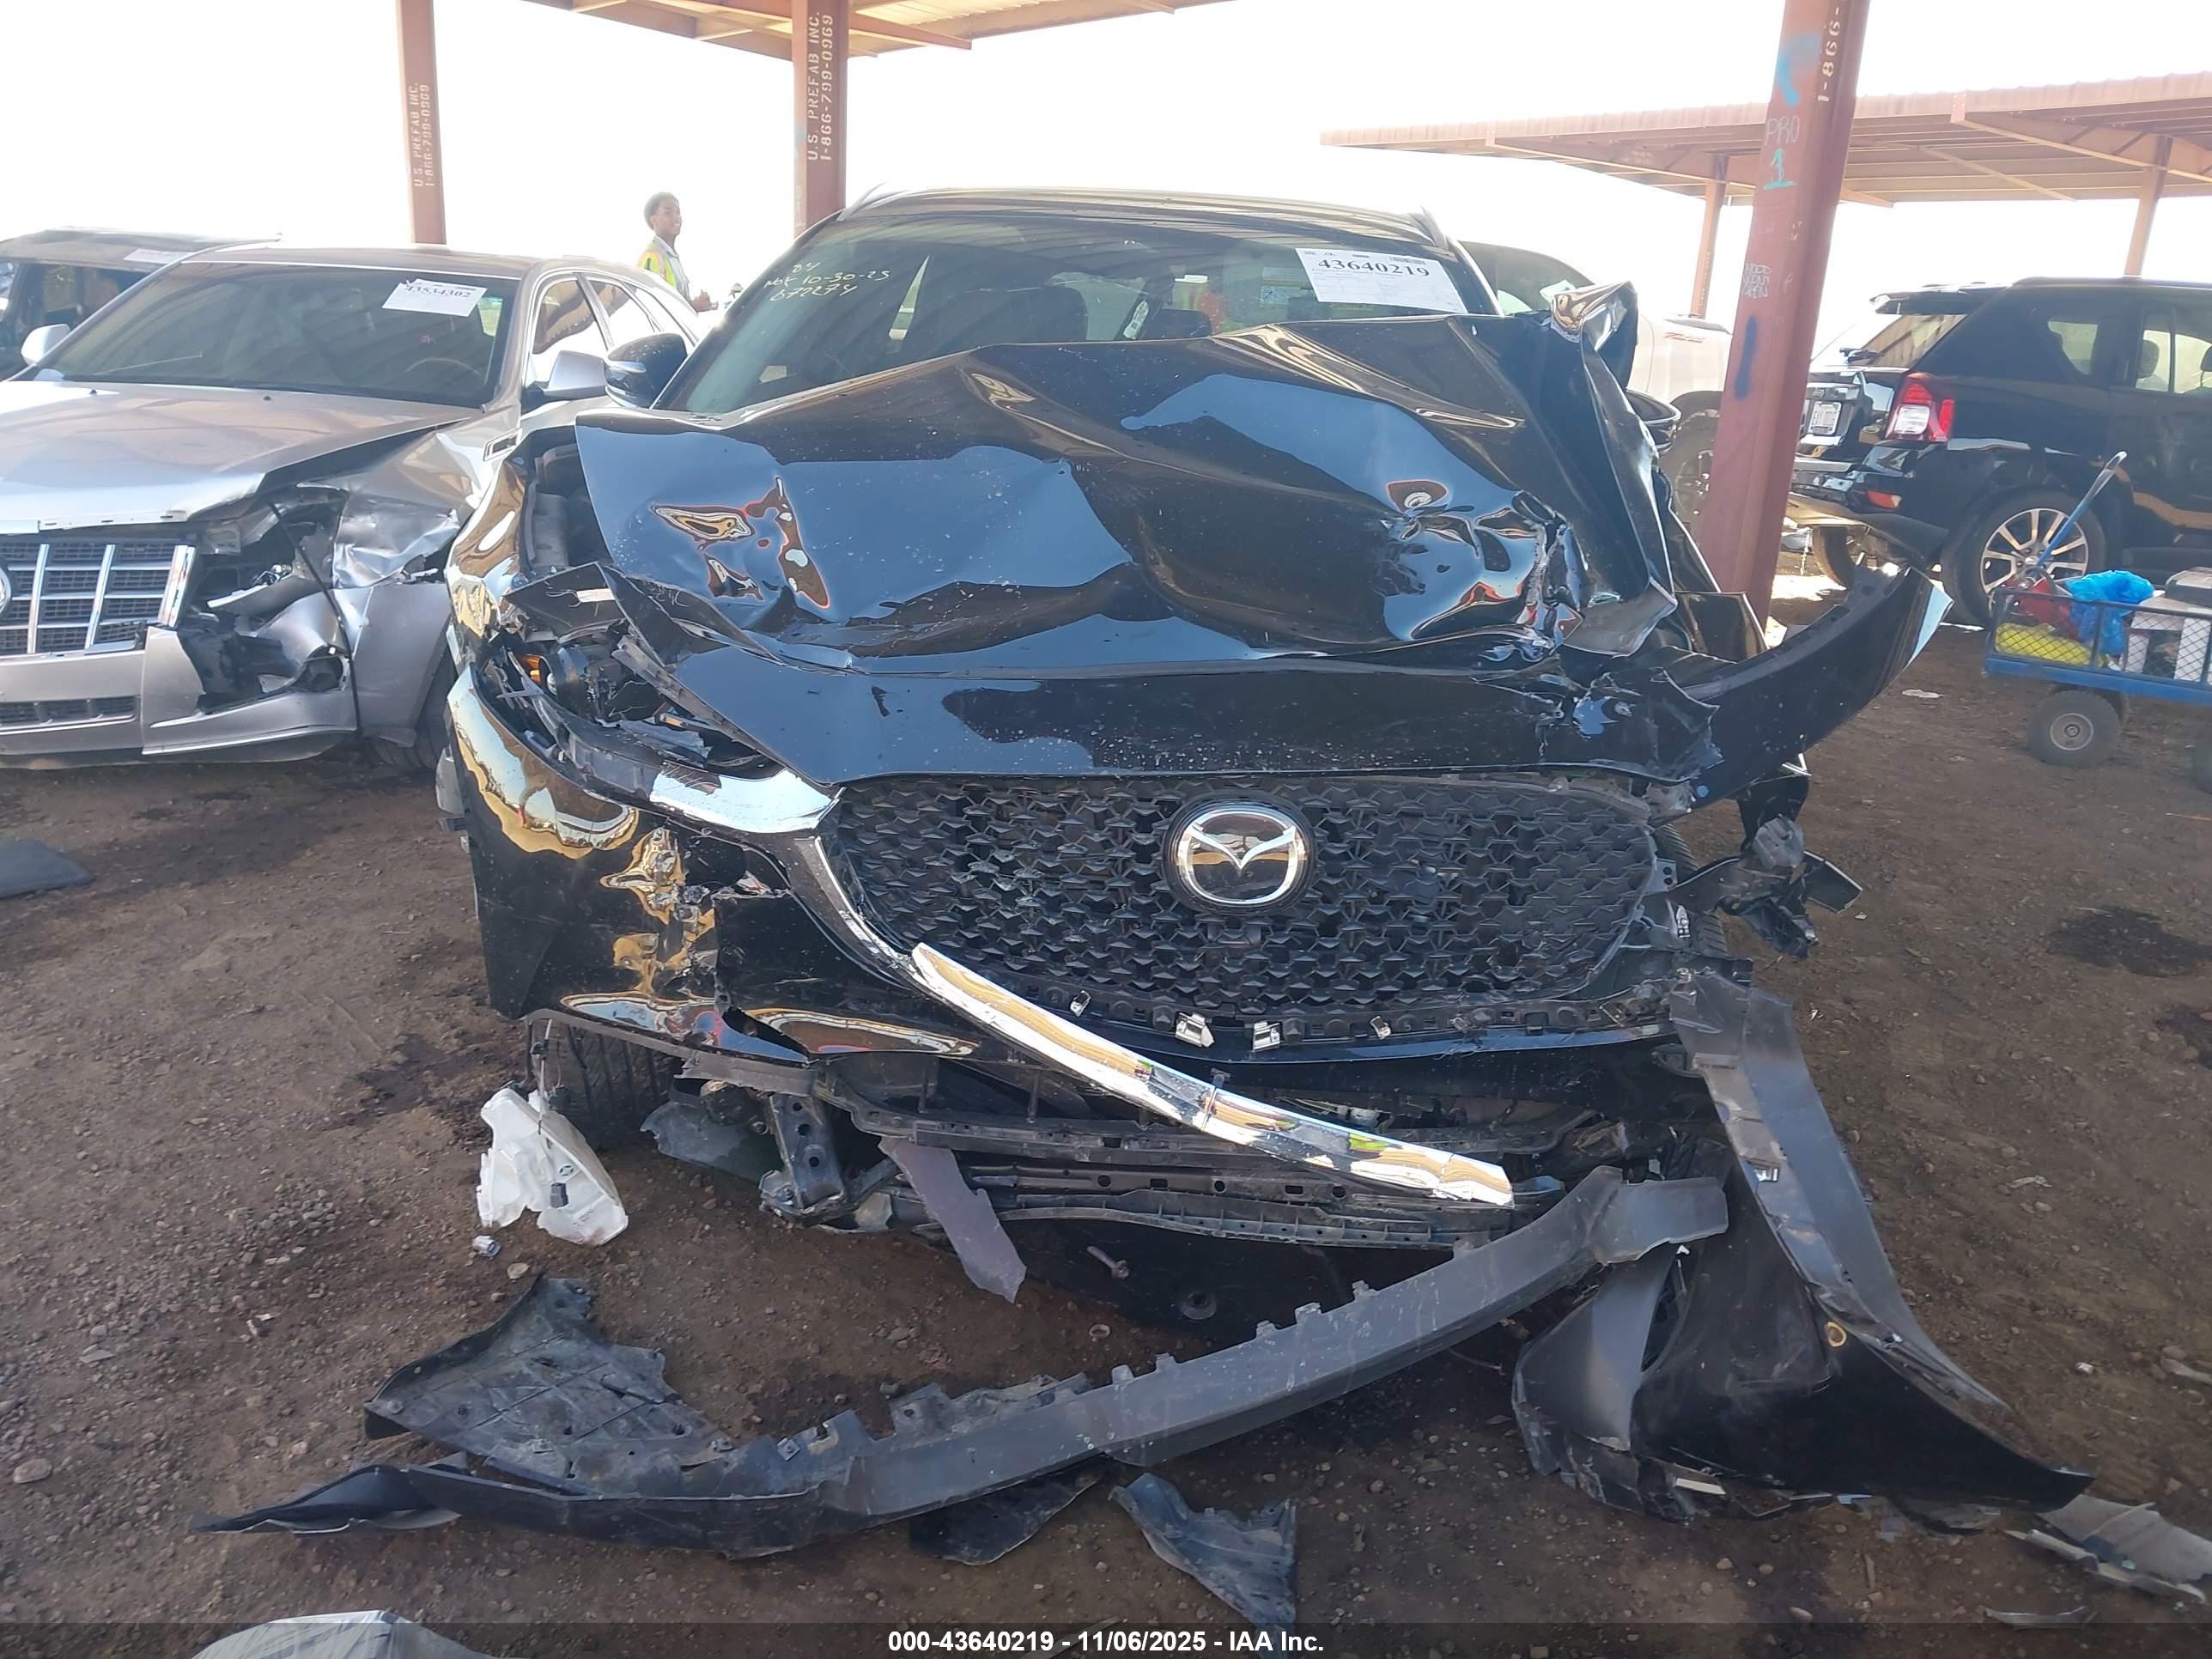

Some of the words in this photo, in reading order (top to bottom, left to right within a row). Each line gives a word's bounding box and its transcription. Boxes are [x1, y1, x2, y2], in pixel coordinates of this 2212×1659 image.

[808, 12, 820, 44] INC.
[808, 52, 819, 119] PREFAB
[821, 15, 833, 161] 1-866-799-0969
[1318, 258, 1430, 276] 43640219
